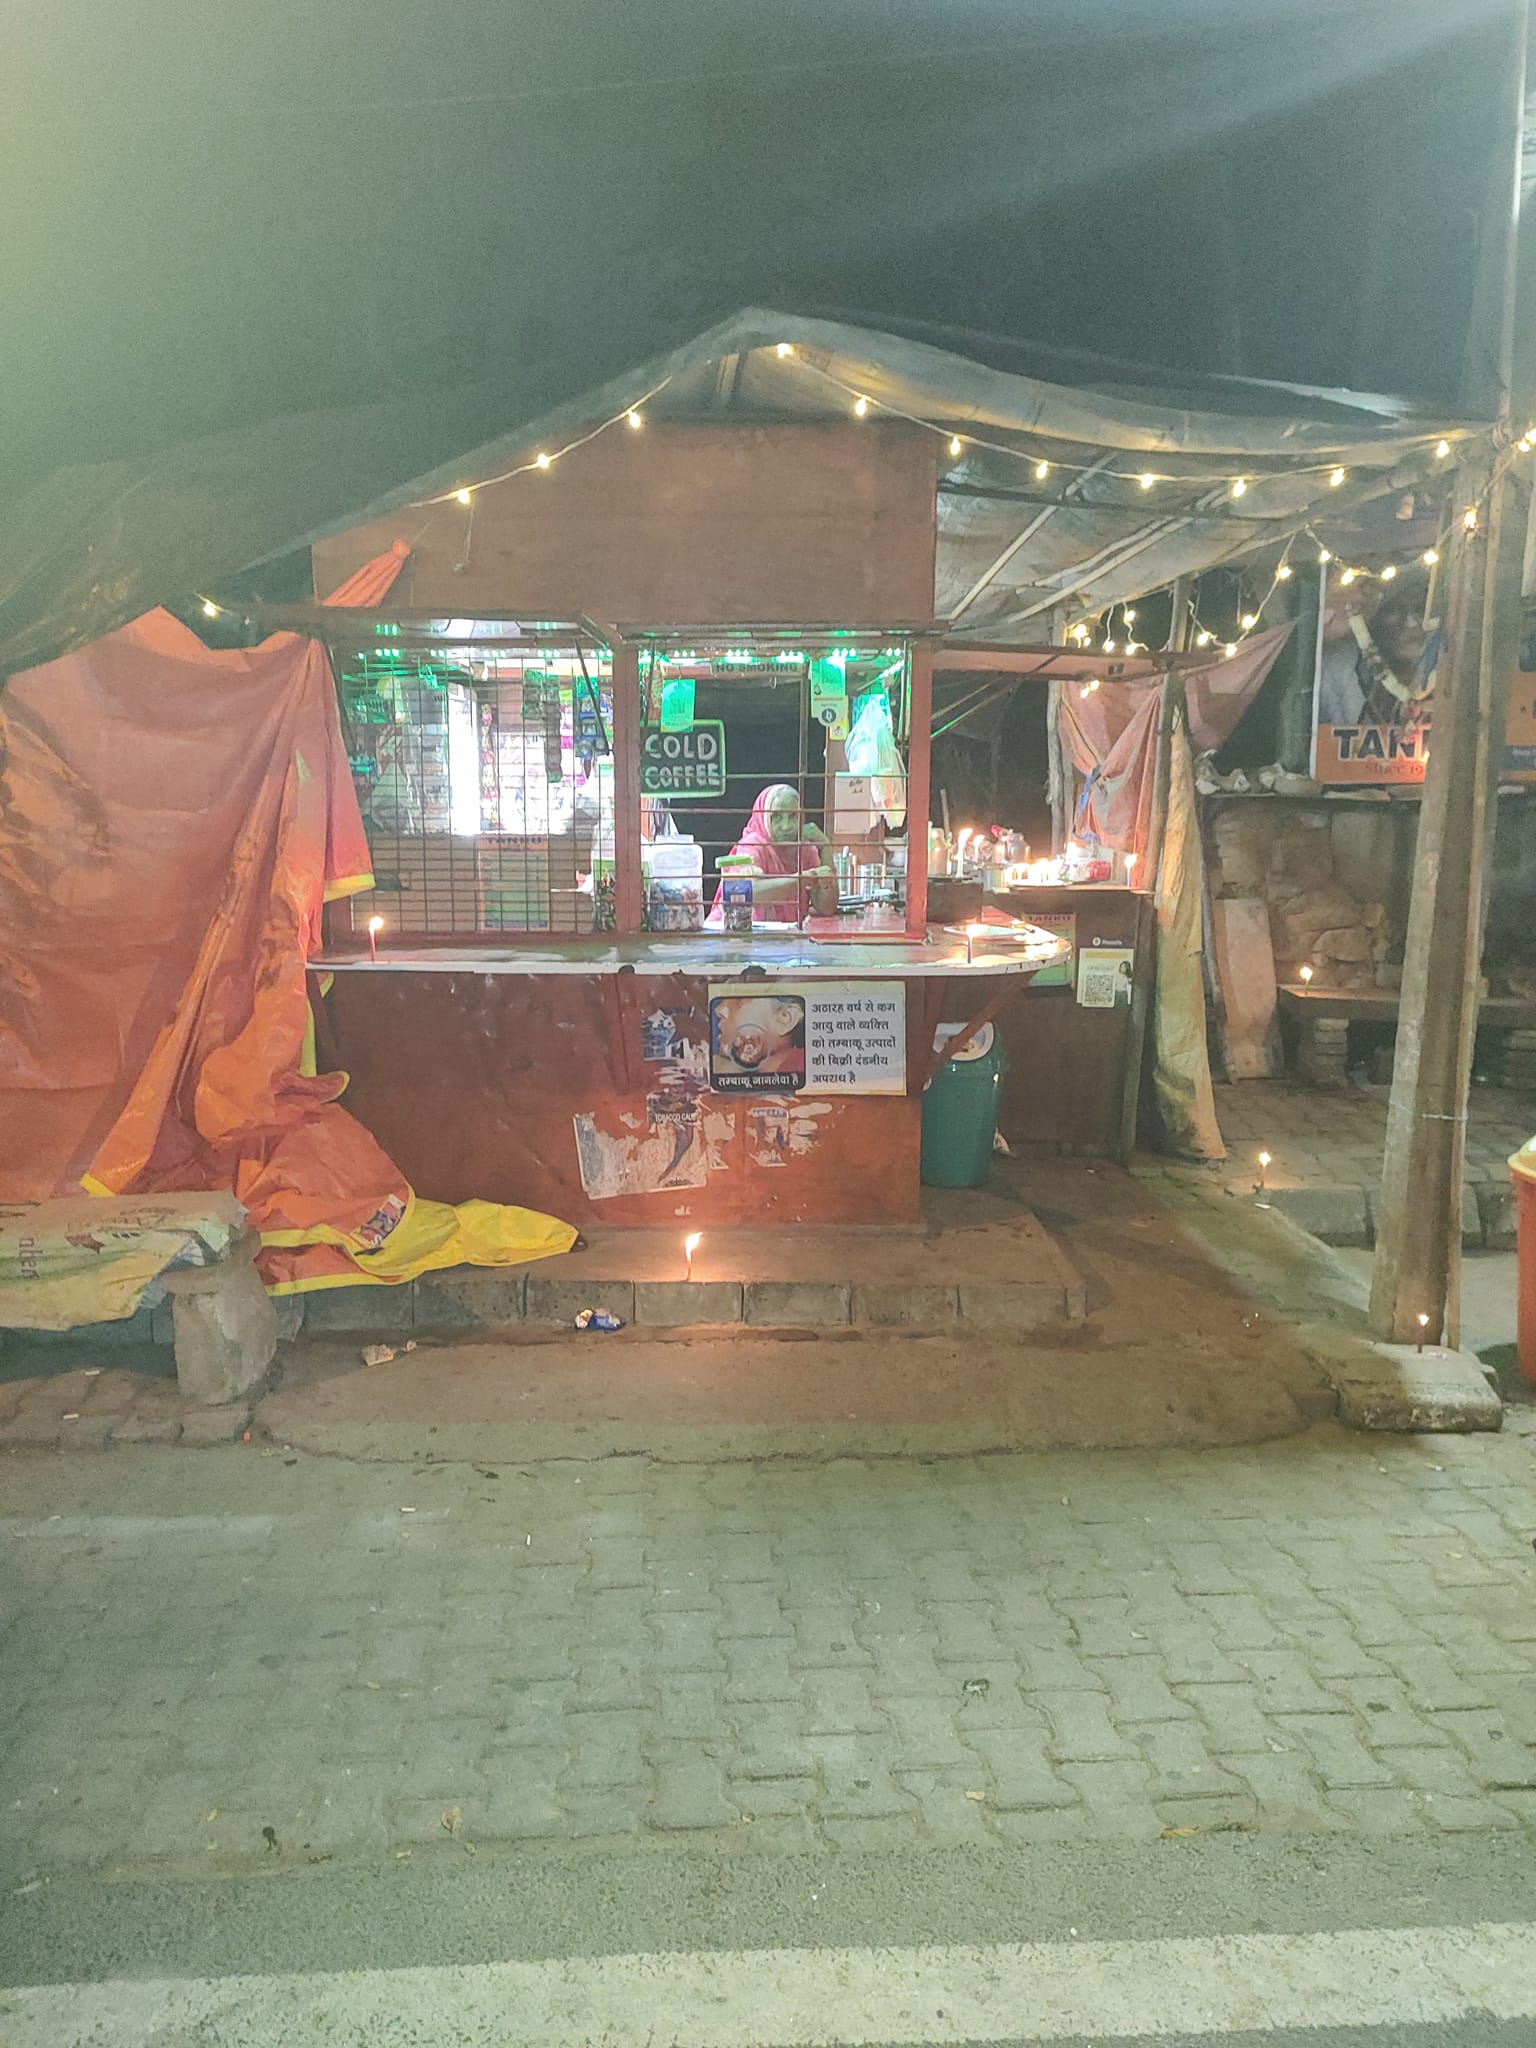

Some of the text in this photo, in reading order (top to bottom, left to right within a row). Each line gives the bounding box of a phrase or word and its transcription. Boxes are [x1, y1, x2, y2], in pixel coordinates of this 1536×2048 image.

[716, 660, 798, 673] NO SMOKING
[645, 733, 718, 760] COLD
[1333, 728, 1431, 760] TAN
[644, 763, 720, 790] COFFEE
[812, 1002, 844, 1014] अठारह
[847, 1000, 862, 1013] वर्ष
[812, 1020, 834, 1034] आयु
[836, 1017, 856, 1031] वाले
[812, 1035, 825, 1049] को
[812, 1053, 825, 1067] की
[848, 1070, 856, 1085] है
